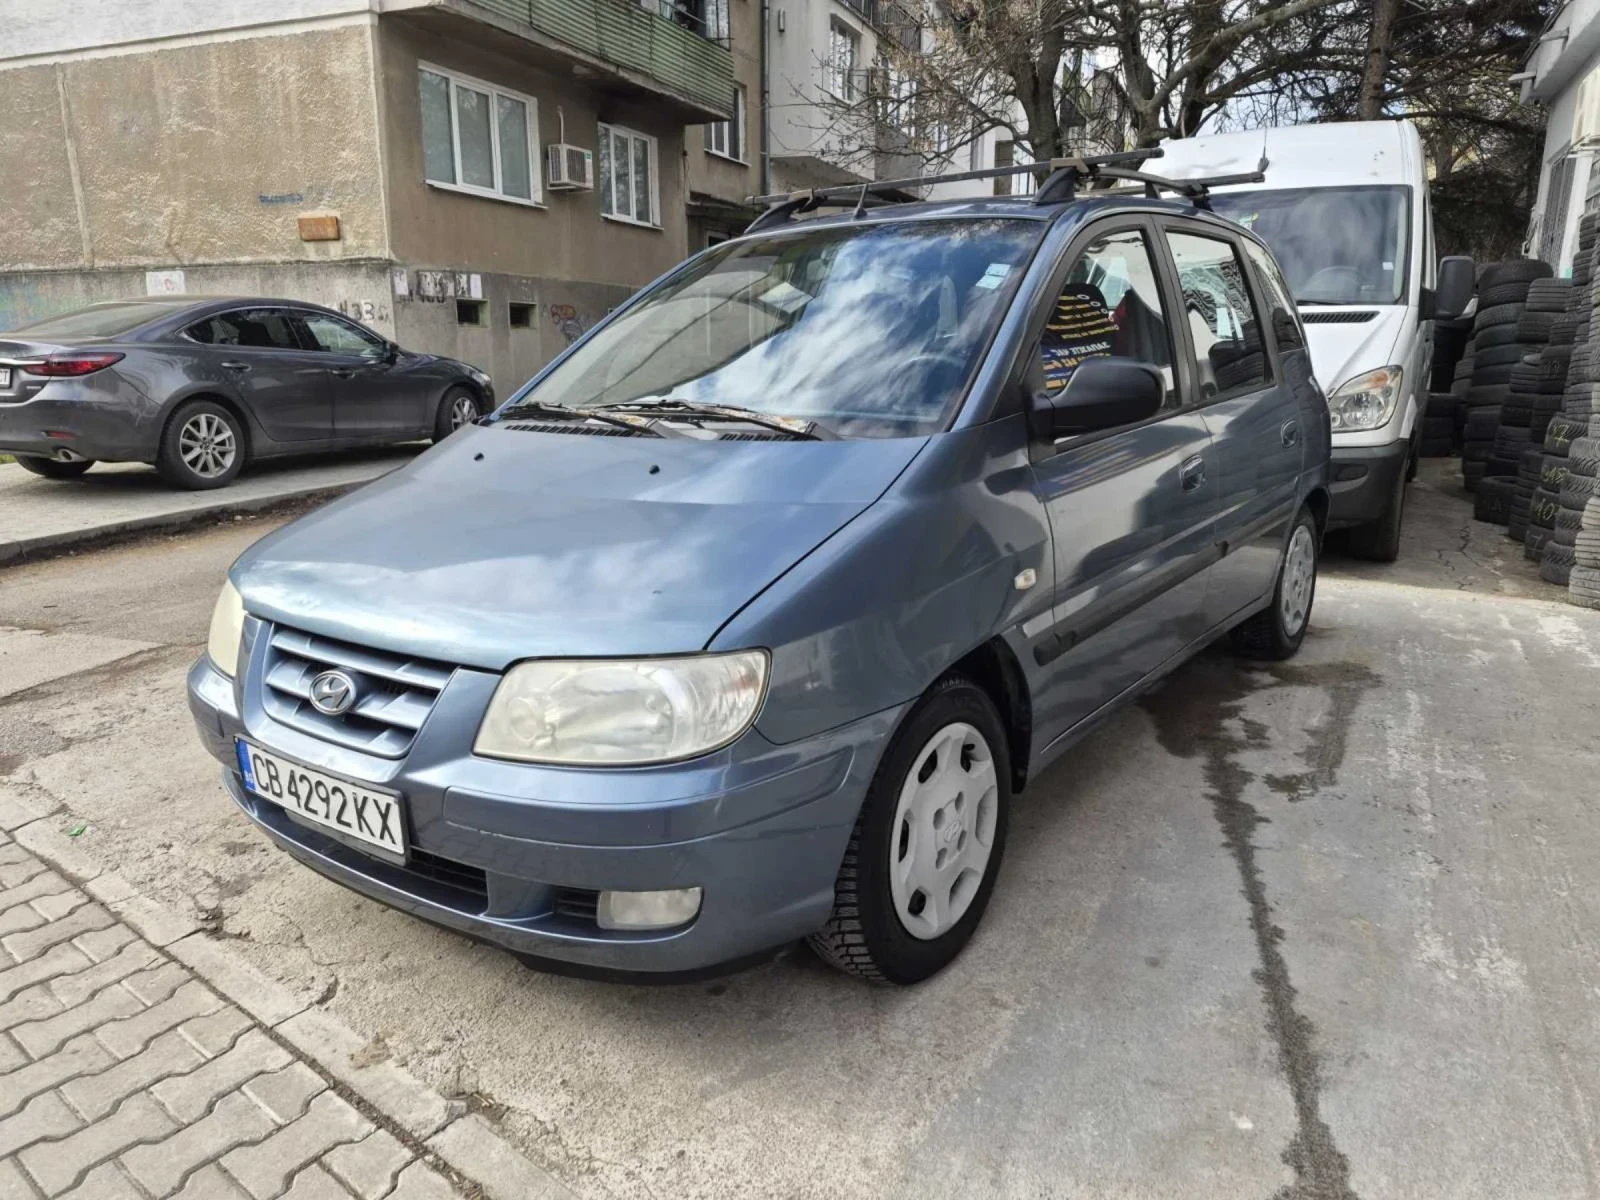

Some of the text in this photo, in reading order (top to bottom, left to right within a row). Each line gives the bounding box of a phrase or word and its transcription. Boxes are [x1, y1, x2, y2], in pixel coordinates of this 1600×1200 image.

[252, 753, 396, 845] CB 4292 KX
